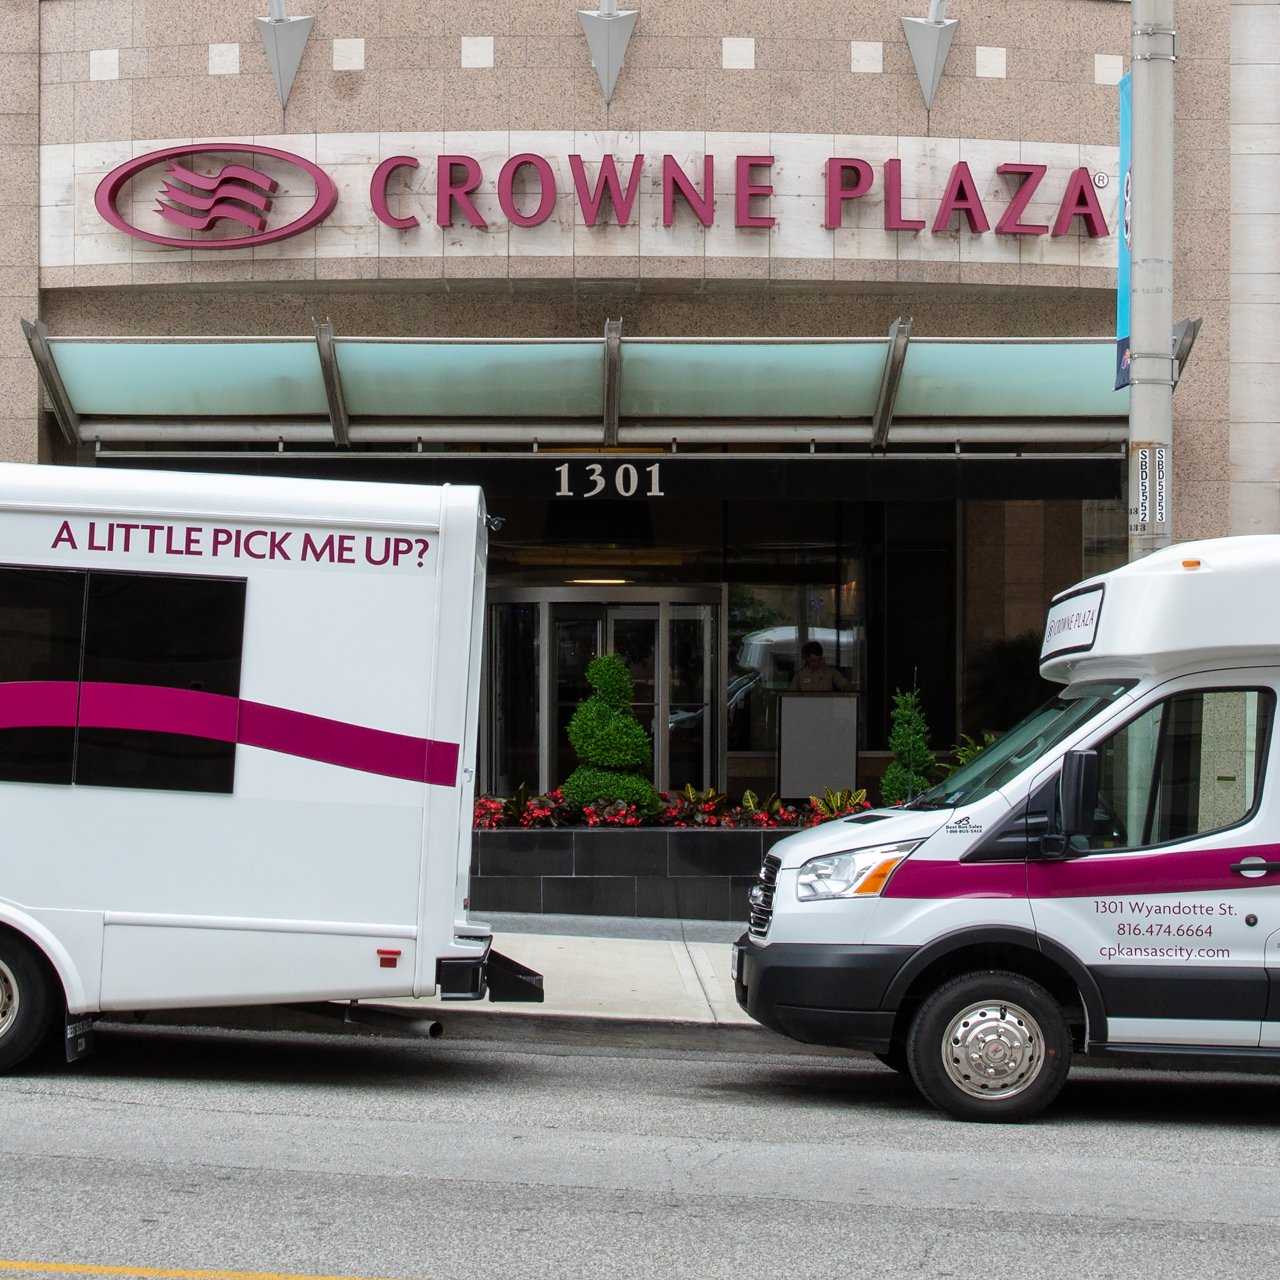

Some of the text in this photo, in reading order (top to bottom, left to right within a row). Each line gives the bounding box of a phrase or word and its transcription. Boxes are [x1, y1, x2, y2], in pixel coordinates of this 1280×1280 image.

[369, 152, 776, 230] CROWNE
[555, 462, 665, 498] 1301
[1140, 449, 1148, 522] SBD5552
[1157, 449, 1165, 522] SBD5553
[51, 520, 430, 569] A LITTLE PICK ME UP?
[1074, 609, 1096, 629] PLAZA
[1094, 900, 1238, 918] 1301 Wyandotte St.
[1117, 923, 1213, 937] 816.474.6664
[1099, 943, 1230, 961] cpkansascity.com
